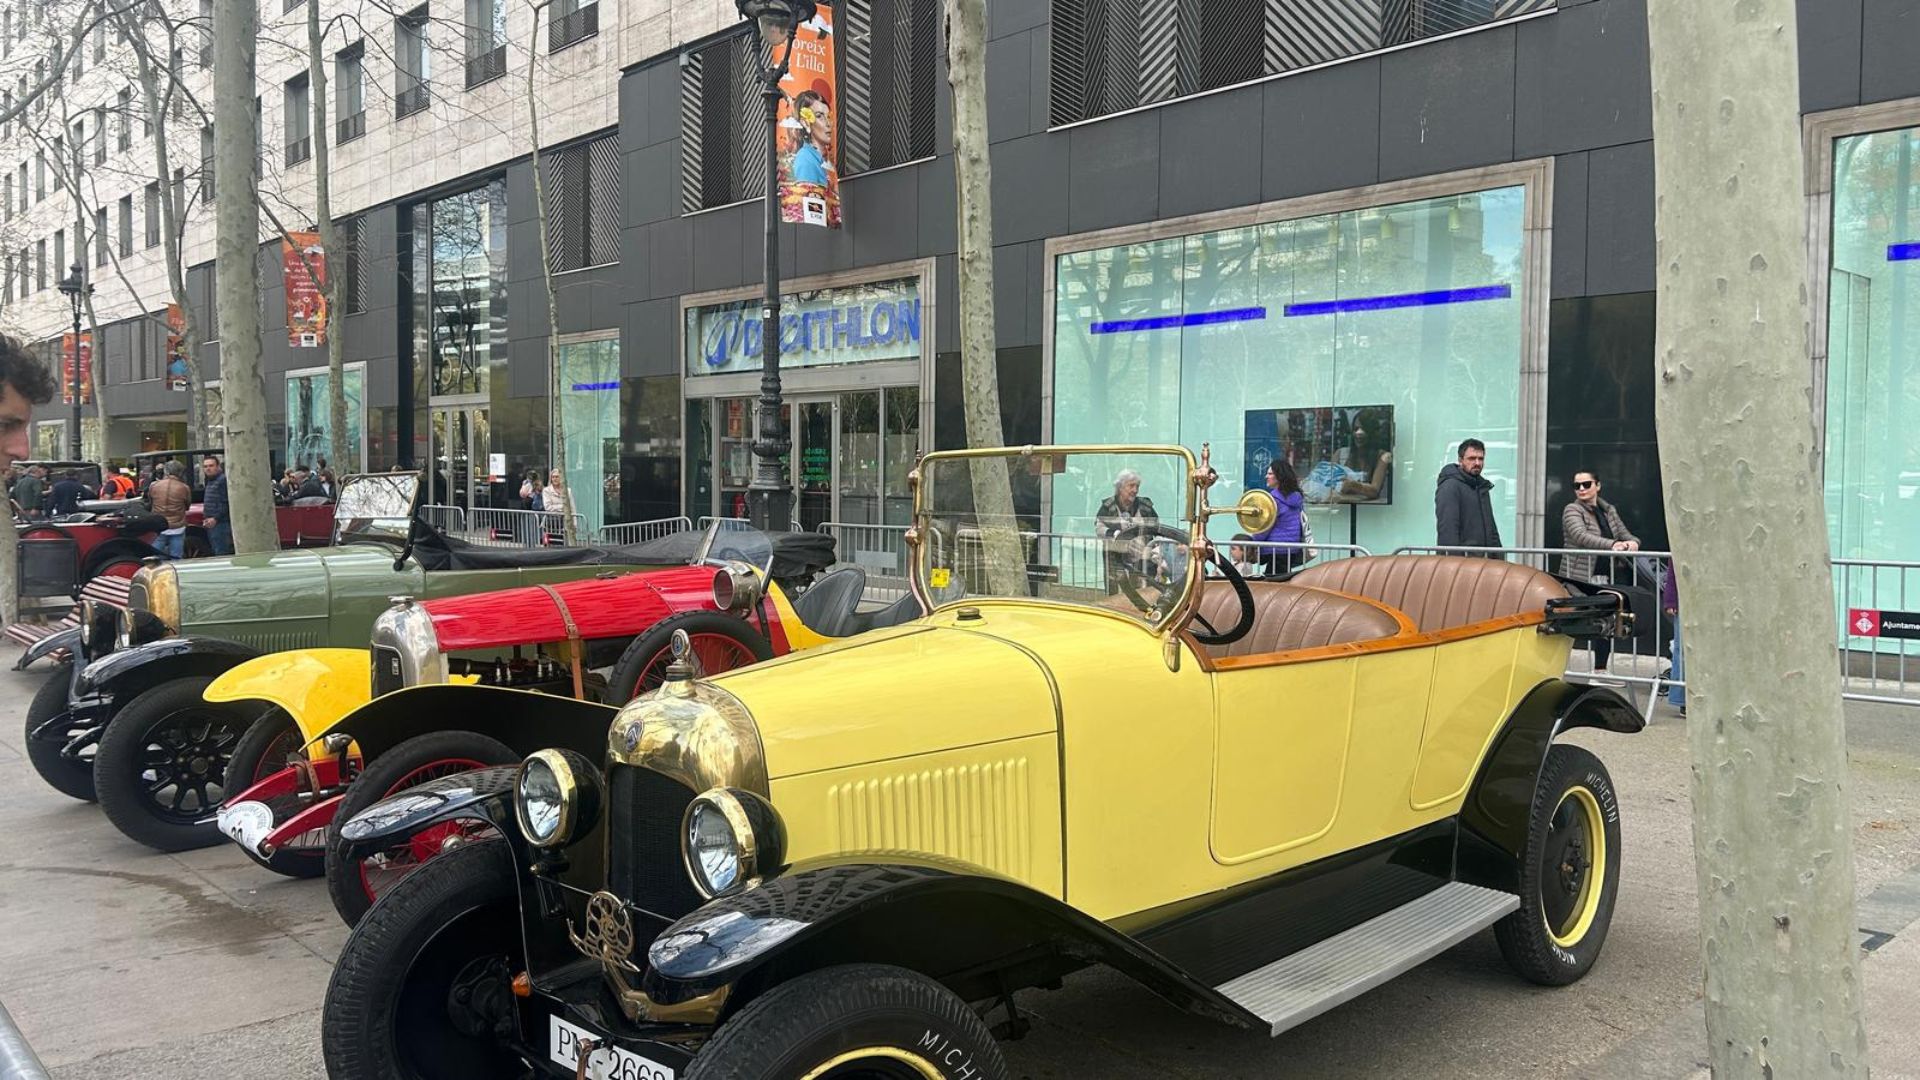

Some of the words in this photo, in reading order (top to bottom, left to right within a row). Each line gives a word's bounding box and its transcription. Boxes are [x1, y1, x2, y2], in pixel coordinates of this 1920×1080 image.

[790, 38, 826, 56] oreix
[796, 52, 826, 74] L'illa
[743, 298, 920, 357] DCATHLON
[1584, 772, 1618, 823] MICHELIN
[917, 1029, 985, 1080] MICH
